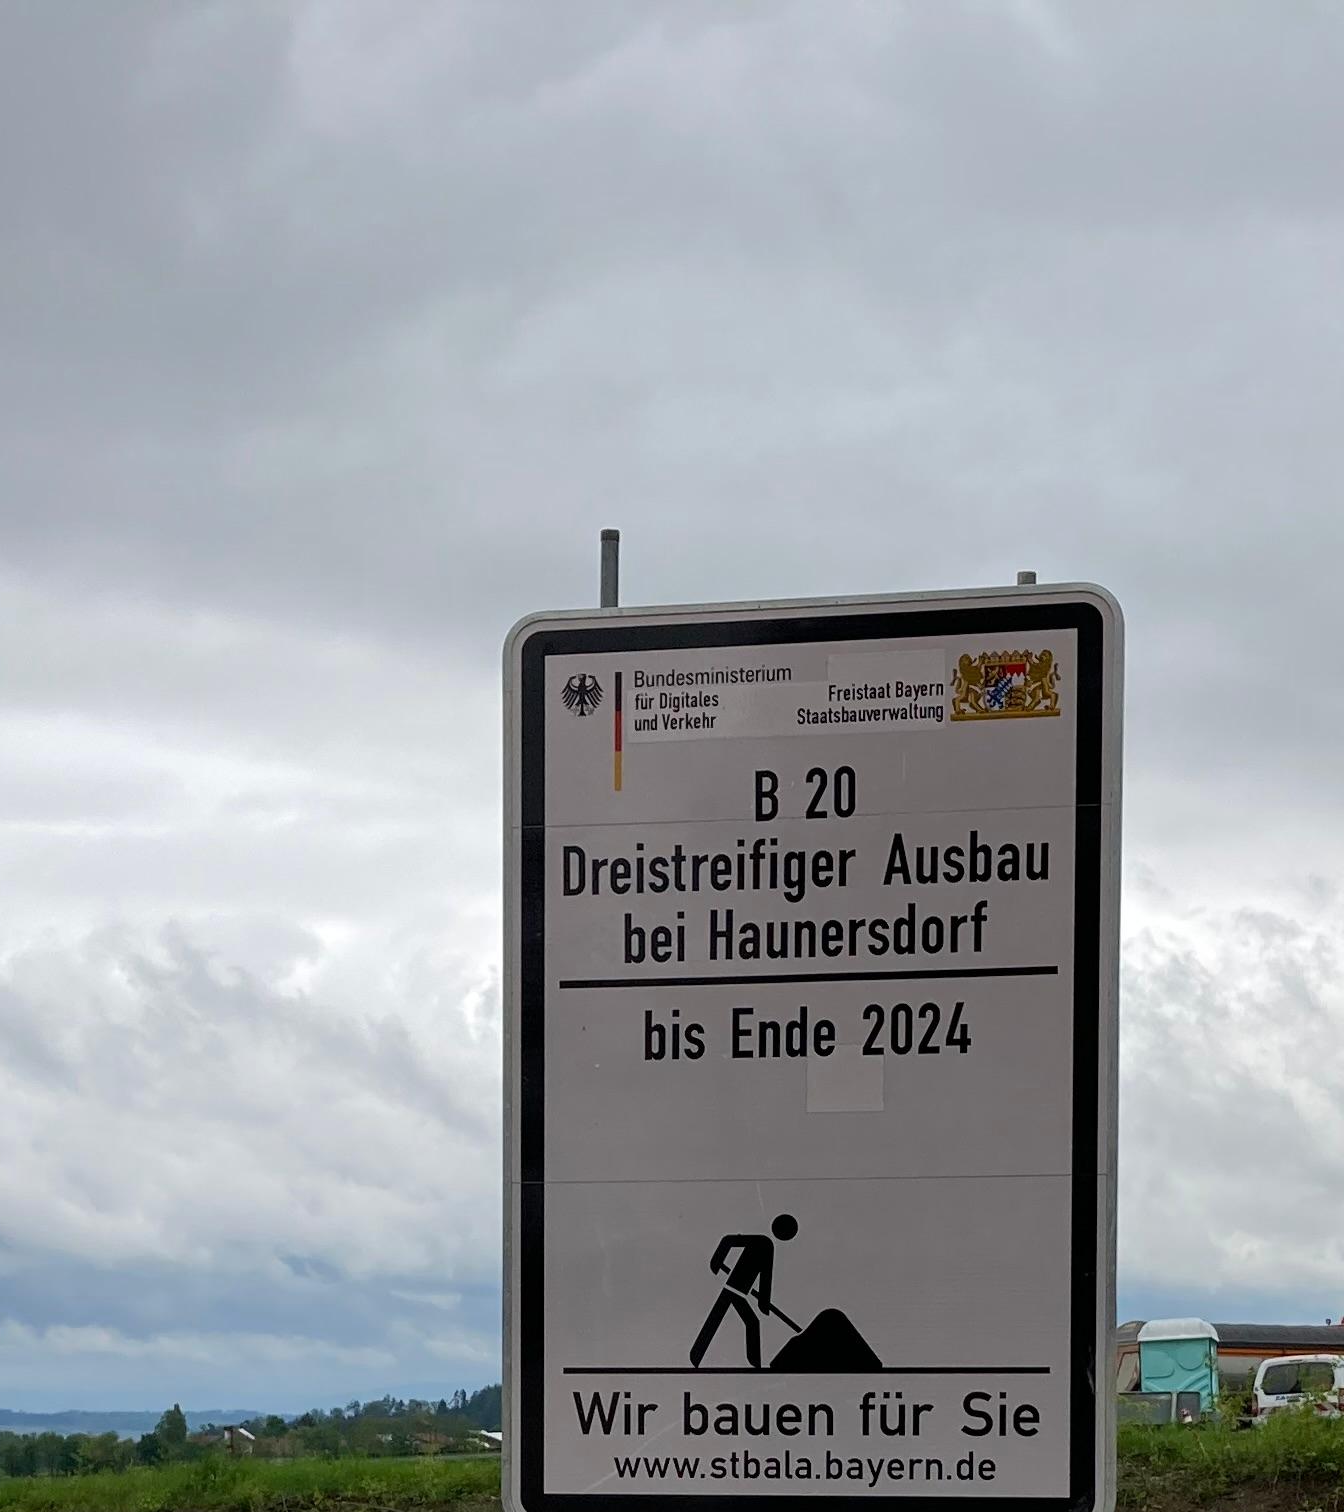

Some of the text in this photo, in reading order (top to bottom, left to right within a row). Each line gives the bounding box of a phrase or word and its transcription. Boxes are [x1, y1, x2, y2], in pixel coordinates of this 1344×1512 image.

[633, 665, 792, 688] Bundesministerium
[828, 680, 944, 702] Freistaat Bayern
[634, 691, 719, 713] für Digitales
[634, 712, 717, 731] und Verkehr
[796, 703, 944, 726] Staatsbauverwaltung
[754, 765, 856, 822] B 20
[562, 829, 1050, 904] Dreistreifiger Ausbau
[624, 899, 988, 964] bei Haunersdorf
[644, 1002, 972, 1061] bis Ende 2024
[572, 1391, 1040, 1437] Wir bauen für Sie
[613, 1449, 997, 1488] www.stbala.bayern.de
